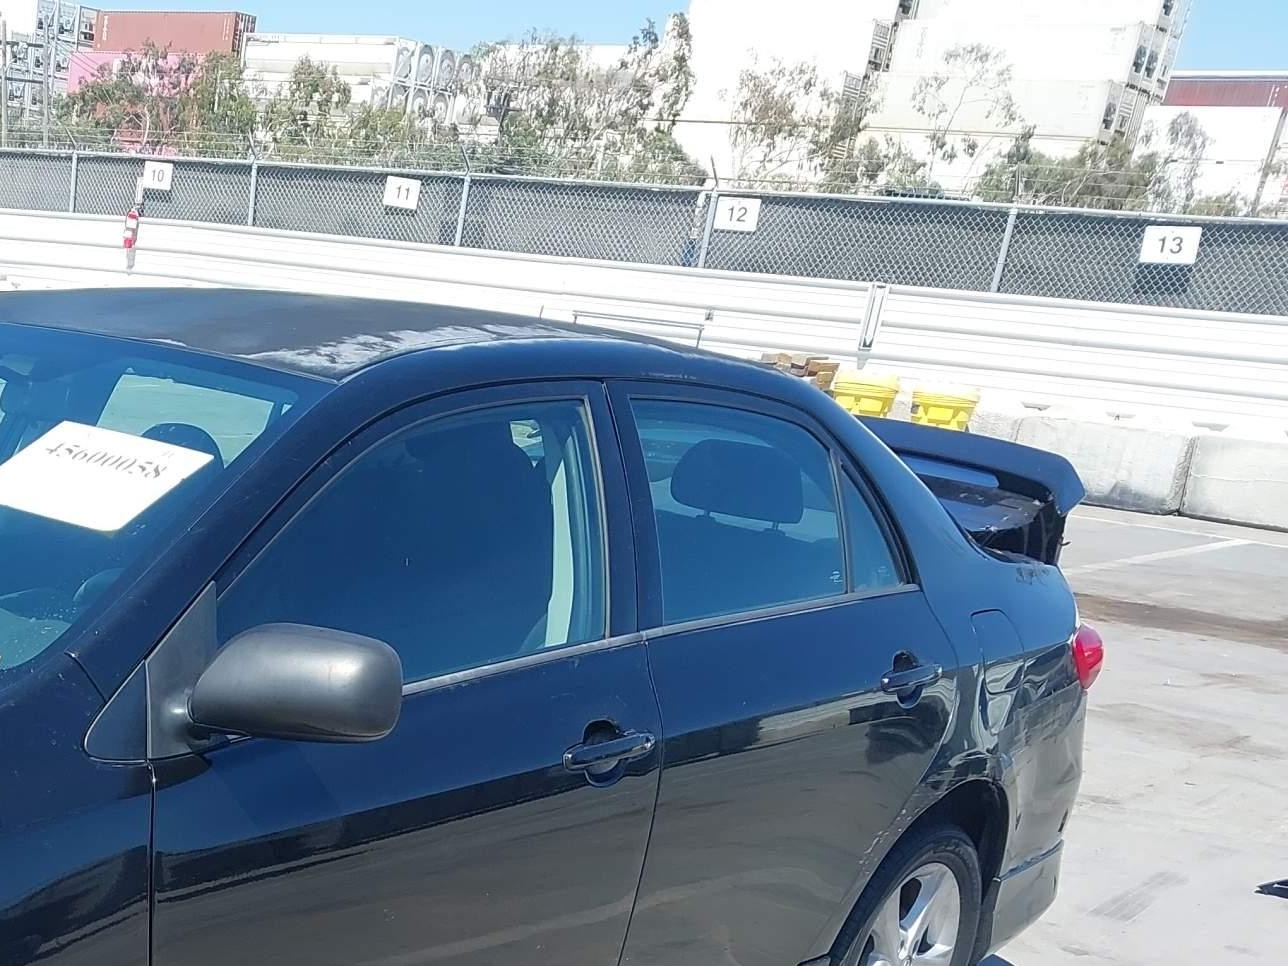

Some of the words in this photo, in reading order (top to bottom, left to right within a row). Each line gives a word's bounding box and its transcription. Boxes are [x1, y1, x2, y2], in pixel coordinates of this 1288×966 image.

[152, 169, 165, 182] 10
[395, 184, 410, 201] 11
[727, 206, 748, 222] 12
[1157, 236, 1184, 254] 13
